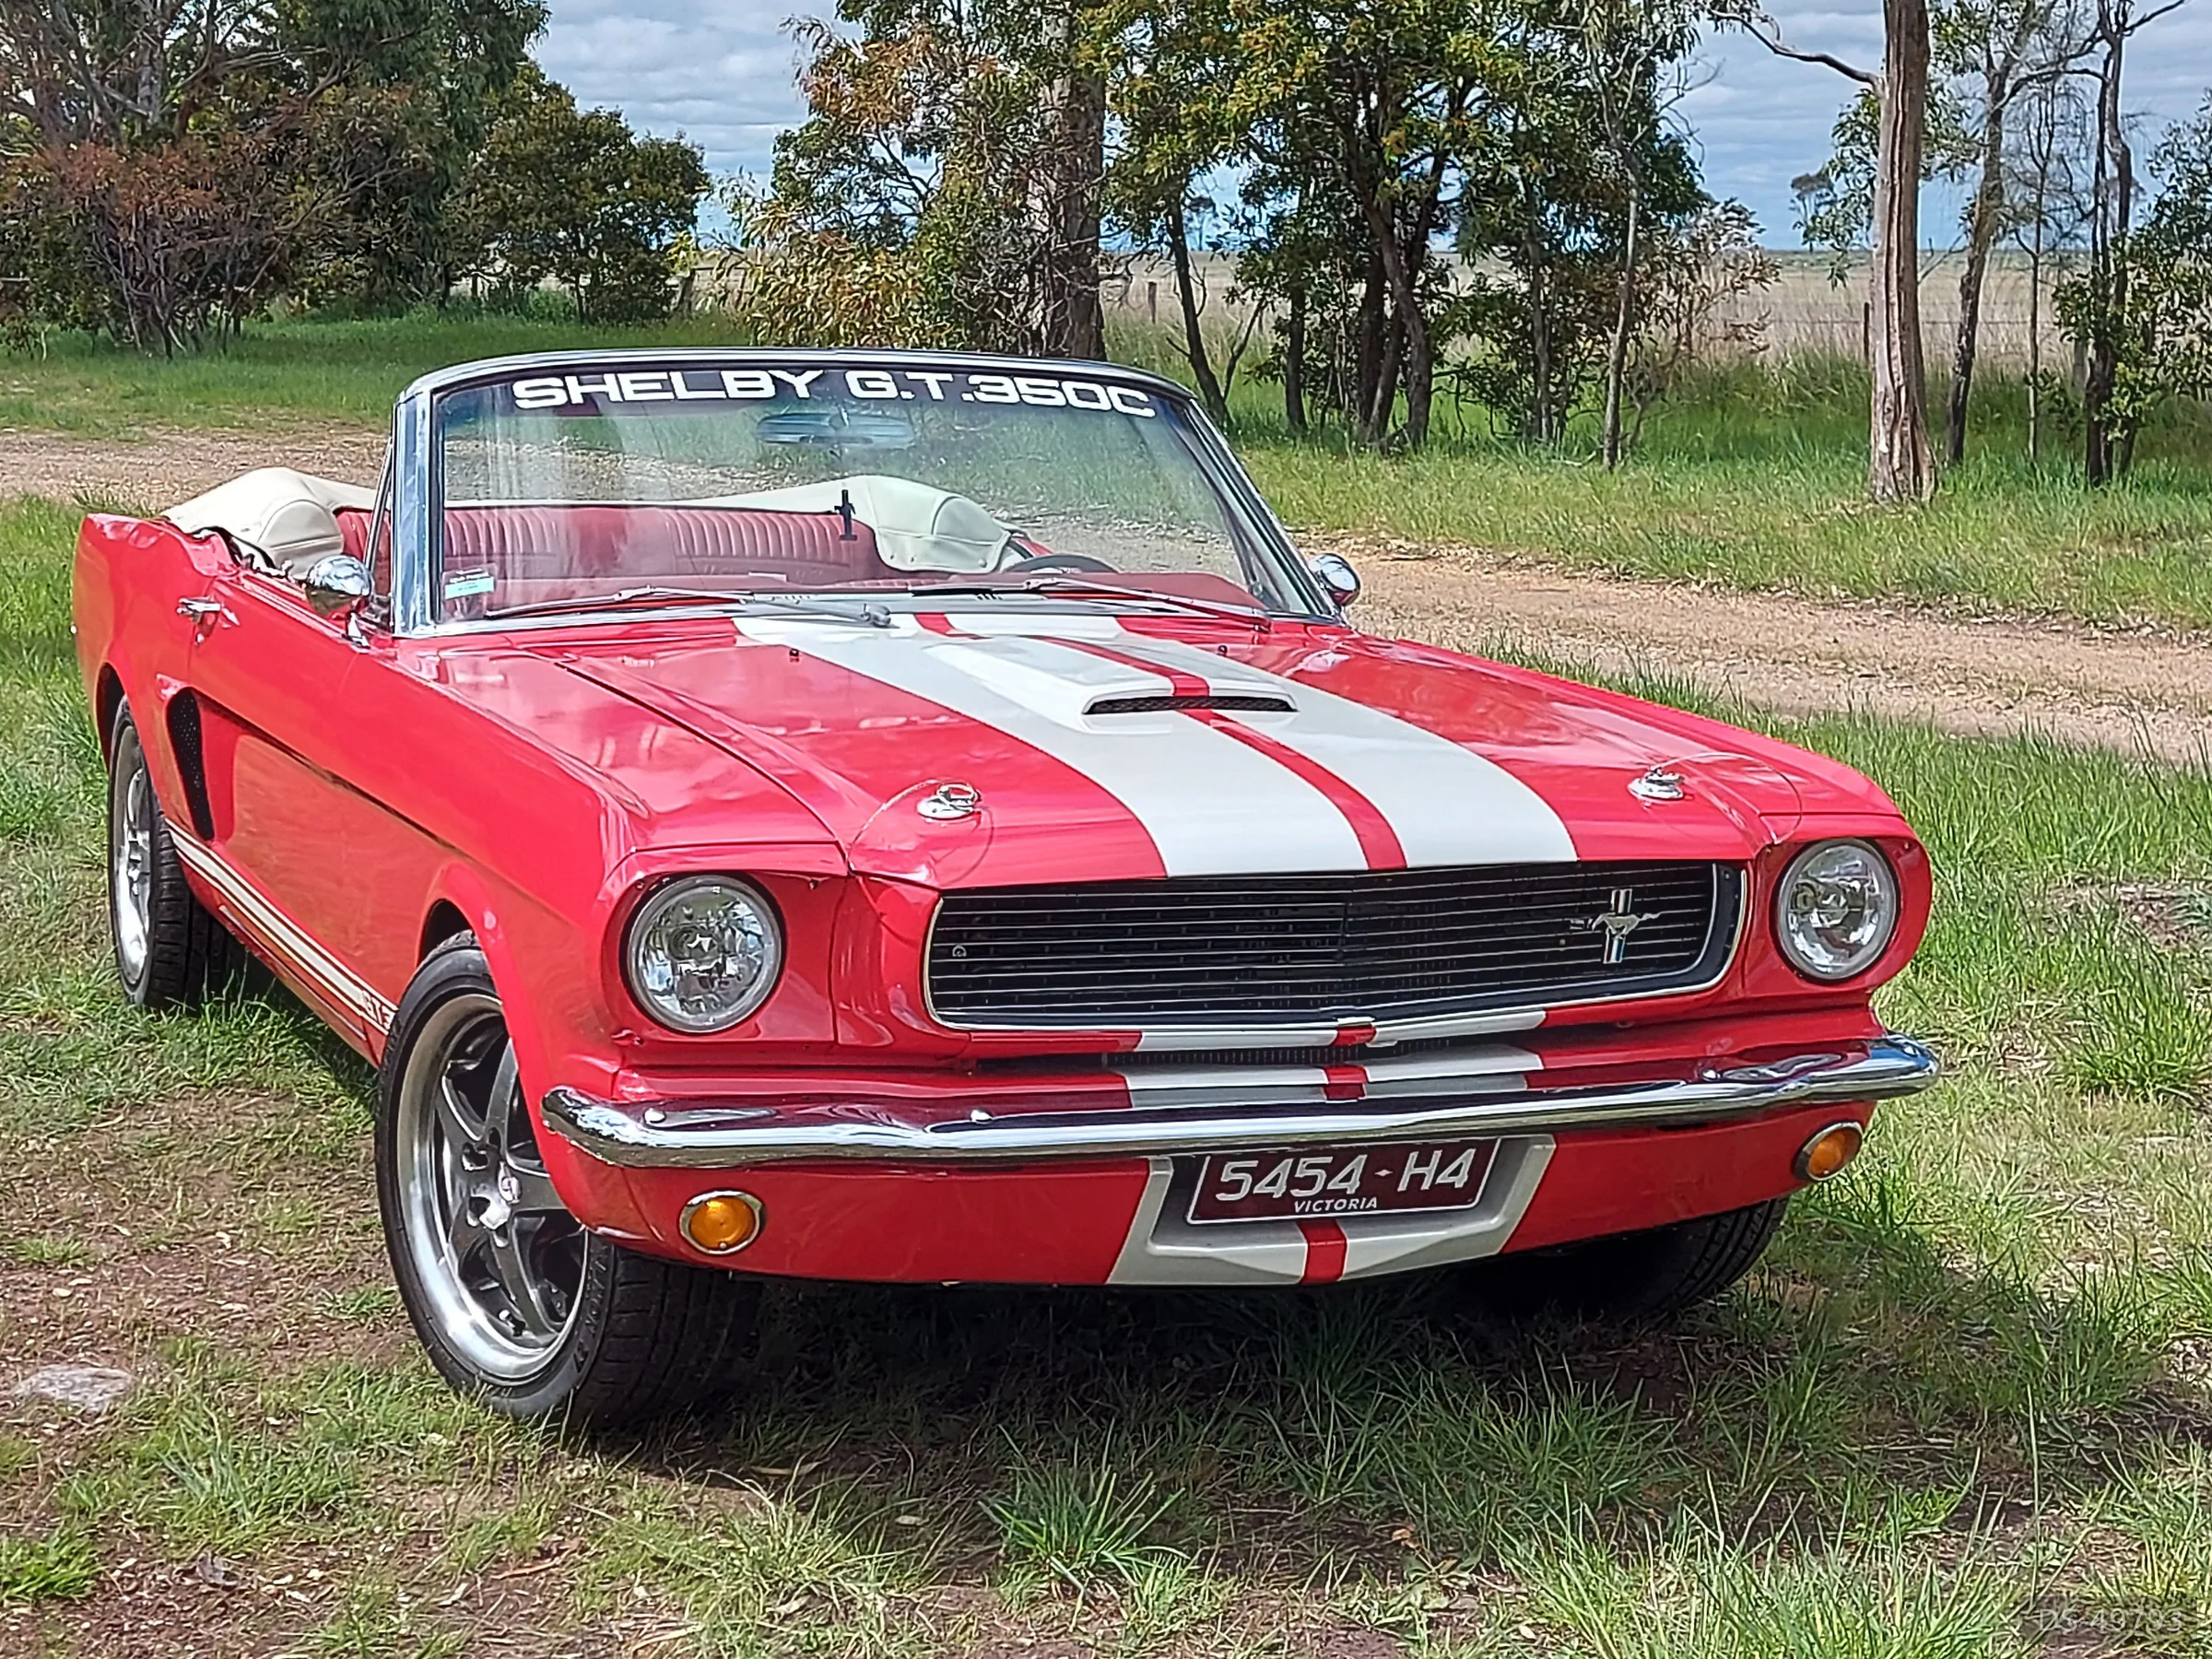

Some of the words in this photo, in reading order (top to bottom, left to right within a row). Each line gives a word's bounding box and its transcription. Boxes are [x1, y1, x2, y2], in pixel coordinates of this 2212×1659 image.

[513, 370, 824, 408] SHELBY
[845, 371, 1156, 418] G.T.350C
[1216, 1154, 1367, 1201] 5454
[1397, 1148, 1477, 1192] H4
[1293, 1196, 1378, 1213] VICTORIA
